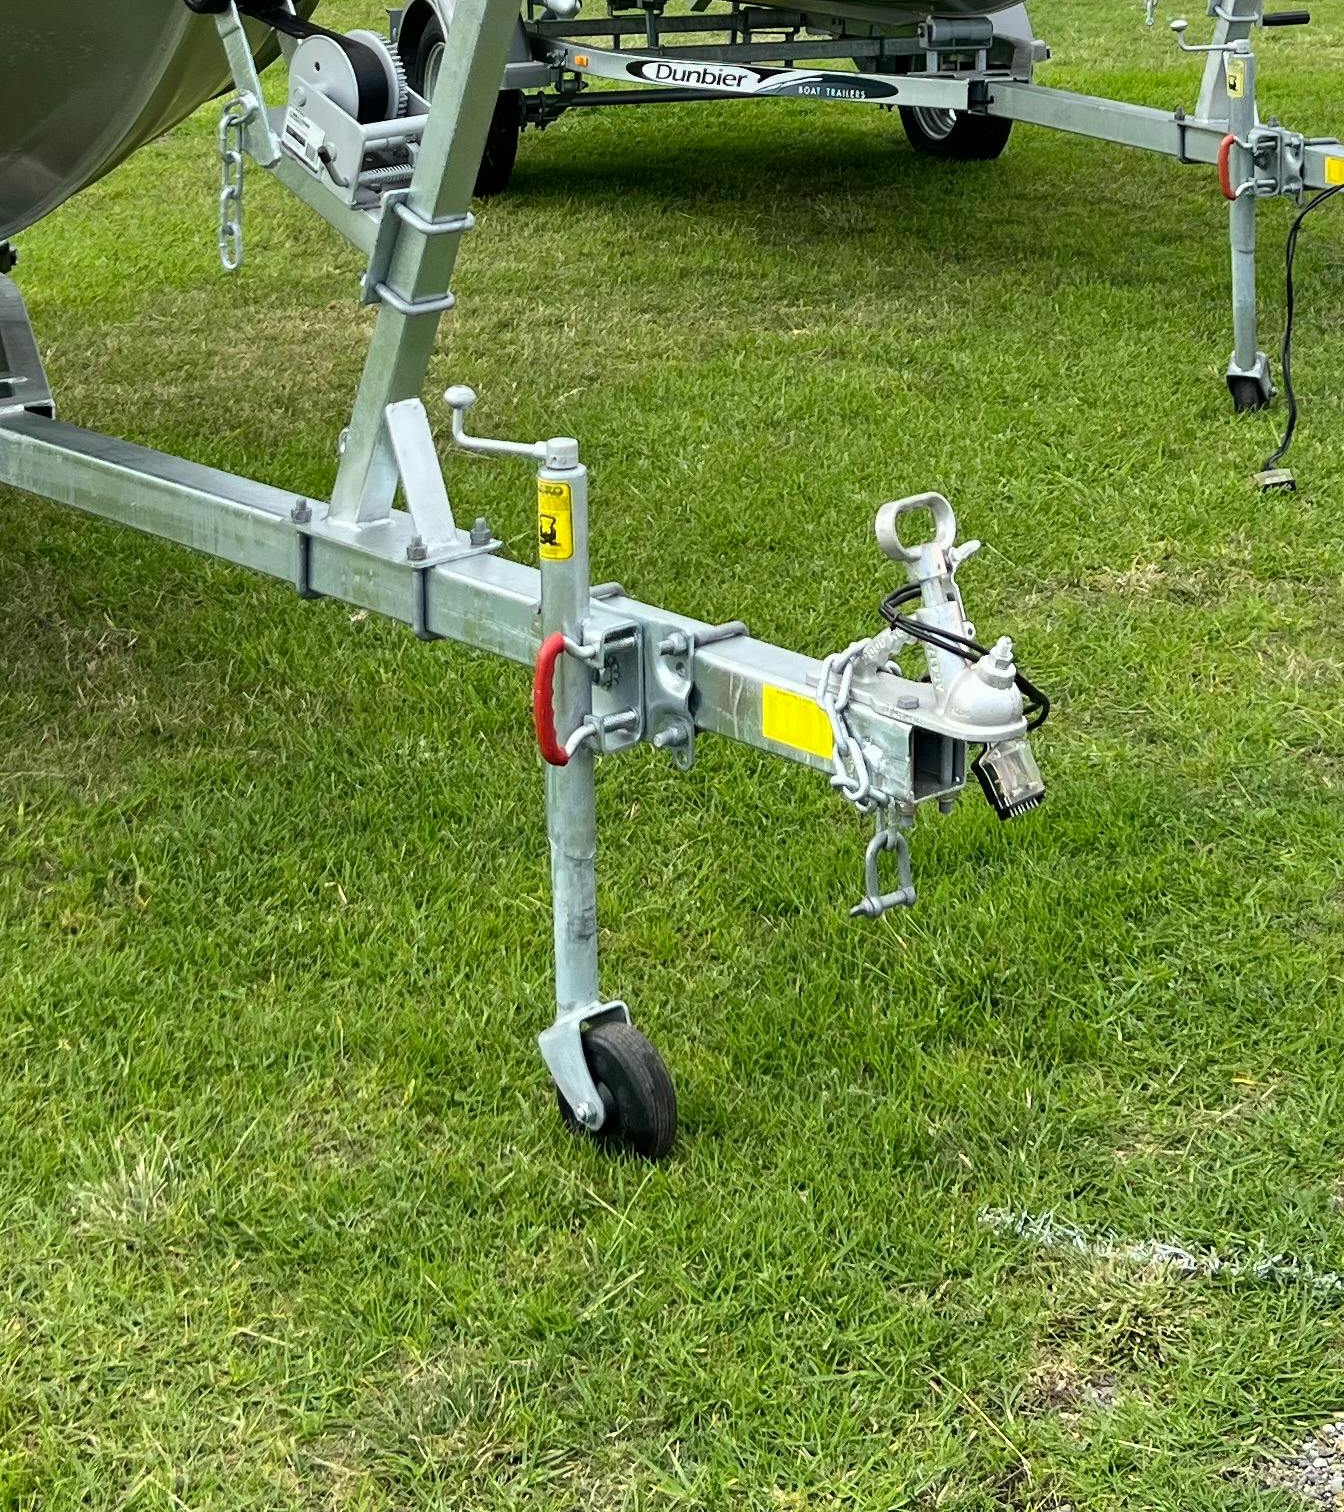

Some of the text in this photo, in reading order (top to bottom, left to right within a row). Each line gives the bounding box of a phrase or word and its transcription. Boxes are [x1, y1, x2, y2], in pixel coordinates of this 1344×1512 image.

[655, 63, 748, 88] Dunbier
[798, 85, 866, 100] BOAT TRAILERS
